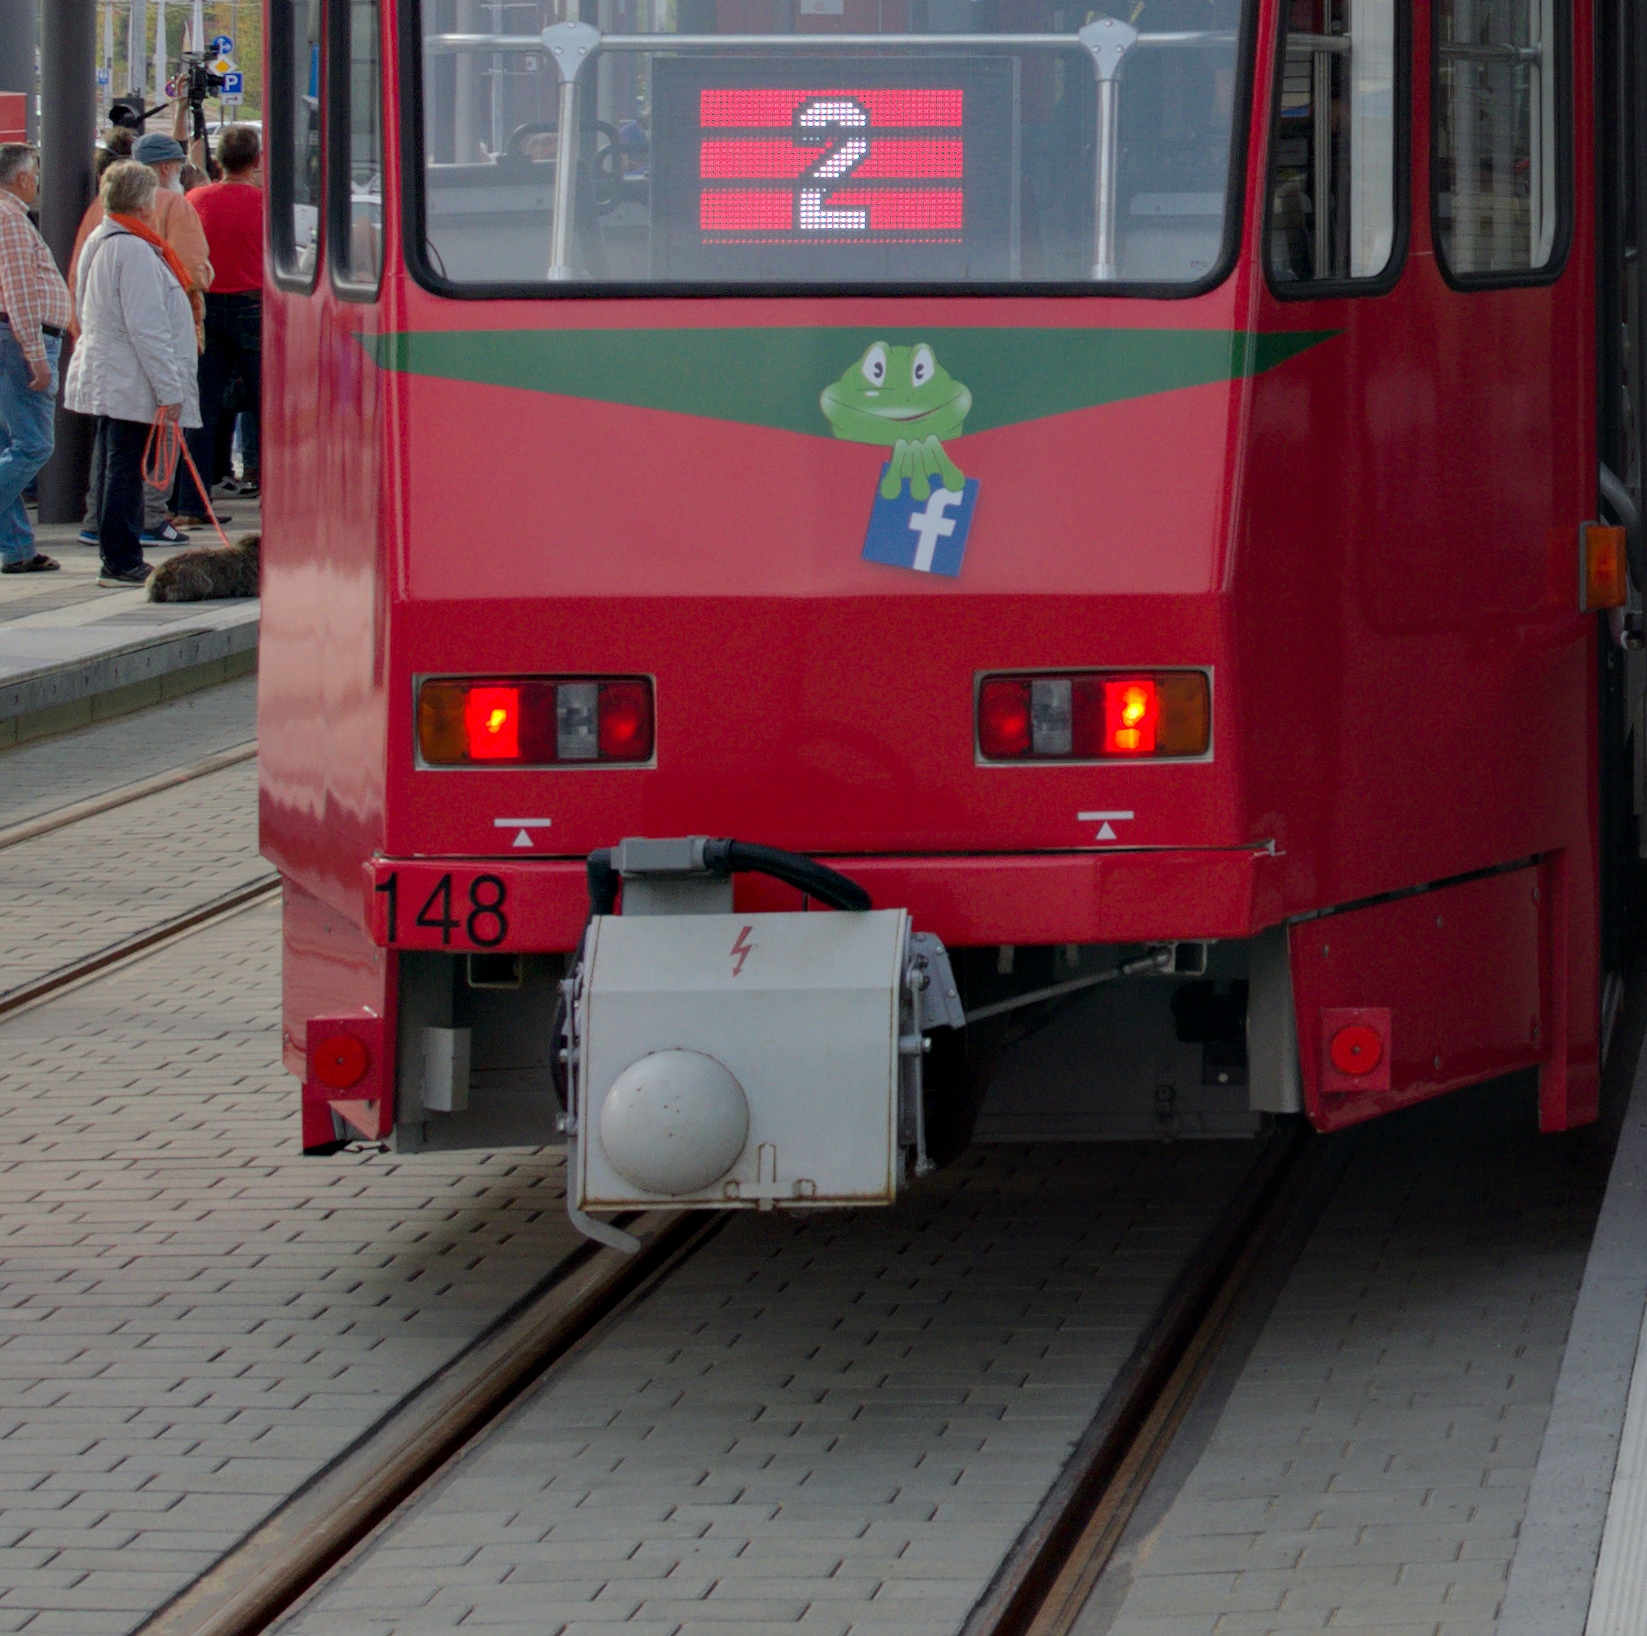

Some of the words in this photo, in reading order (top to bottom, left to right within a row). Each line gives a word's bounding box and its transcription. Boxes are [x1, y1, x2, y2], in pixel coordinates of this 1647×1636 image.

[225, 74, 239, 92] P
[799, 101, 867, 230] 2
[374, 871, 509, 950] 148
